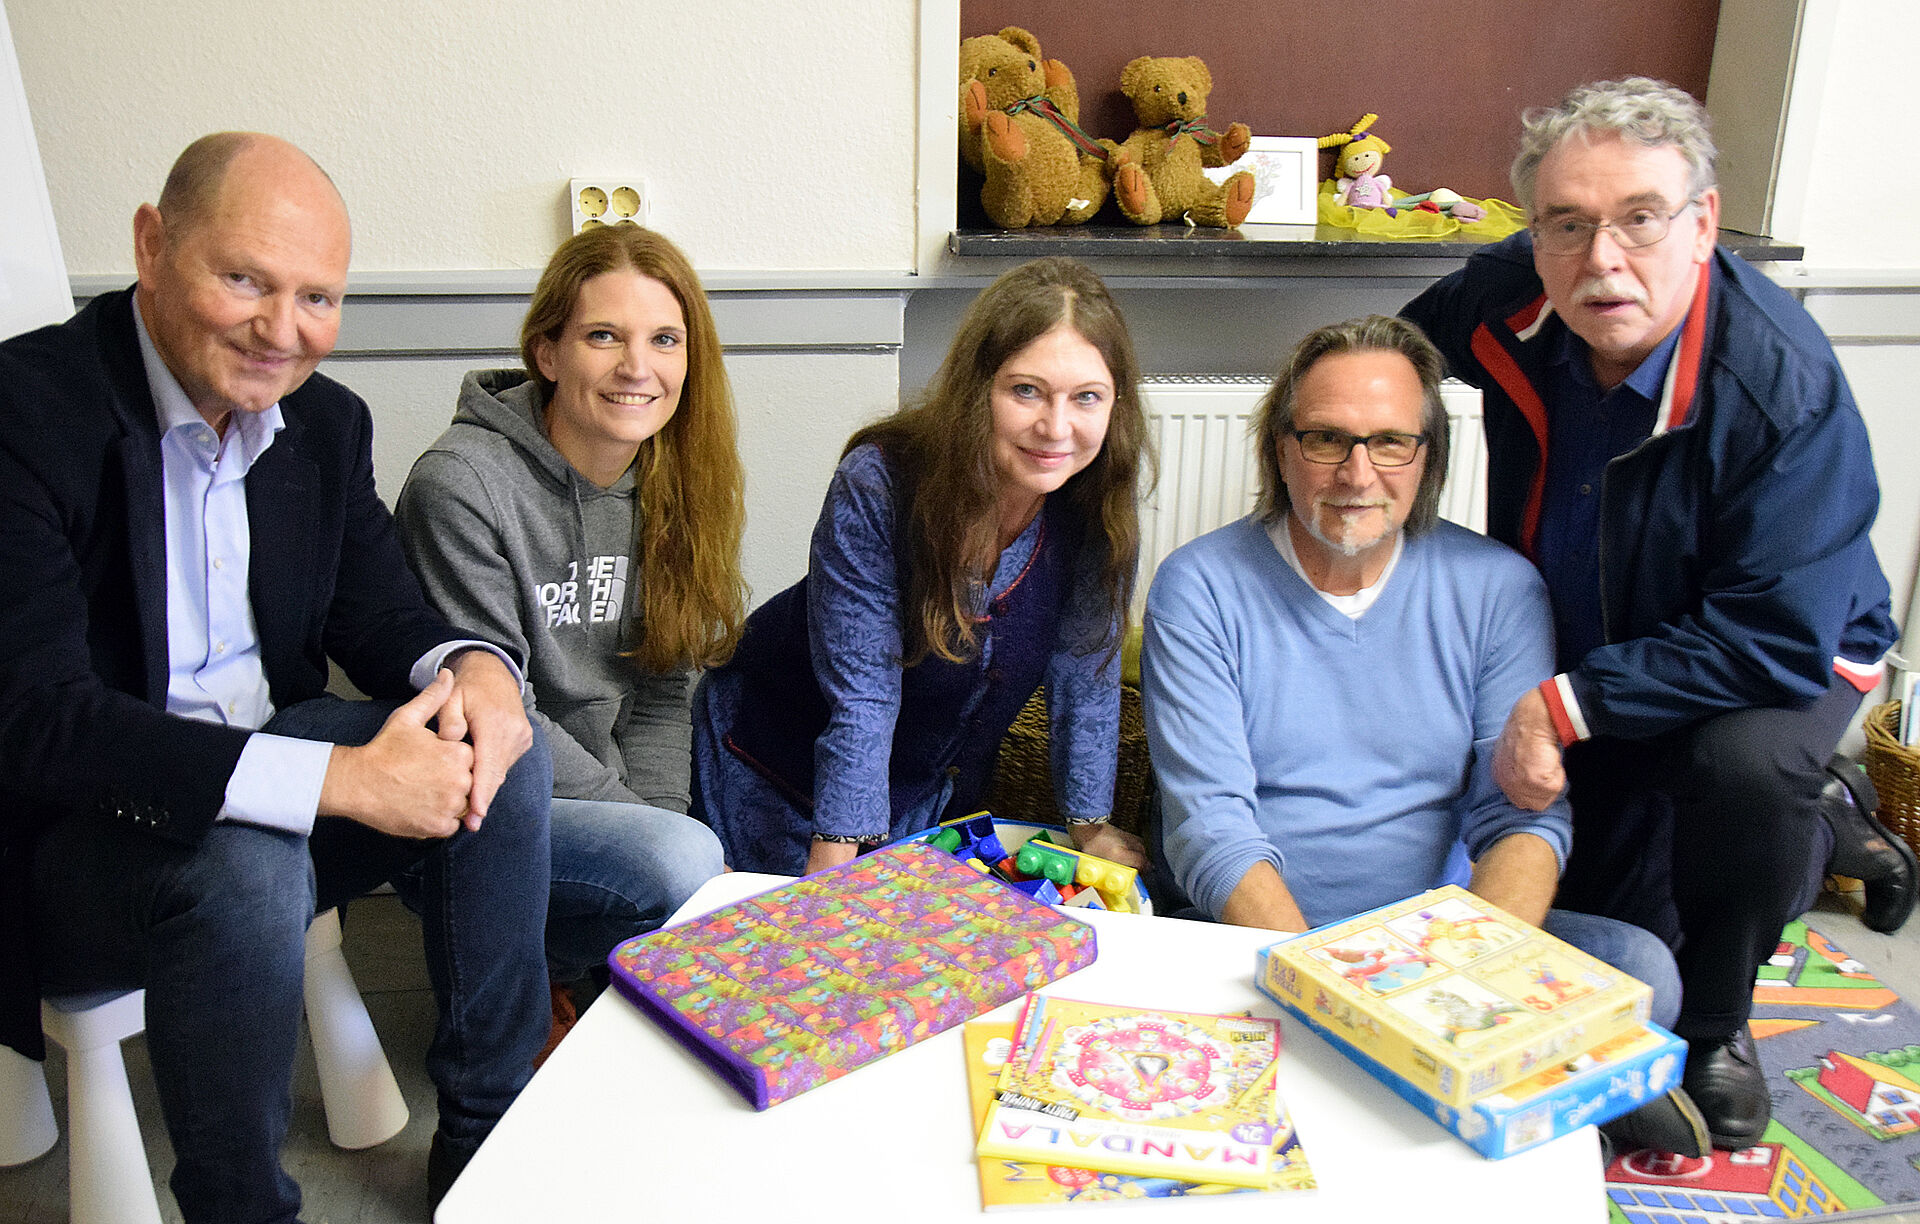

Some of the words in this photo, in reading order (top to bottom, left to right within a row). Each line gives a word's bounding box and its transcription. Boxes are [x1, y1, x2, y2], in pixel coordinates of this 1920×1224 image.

[535, 578, 611, 607] ORH
[999, 1090, 1043, 1111] ANIMAL
[1042, 1102, 1077, 1120] PARTY
[999, 1120, 1258, 1166] MANDALA
